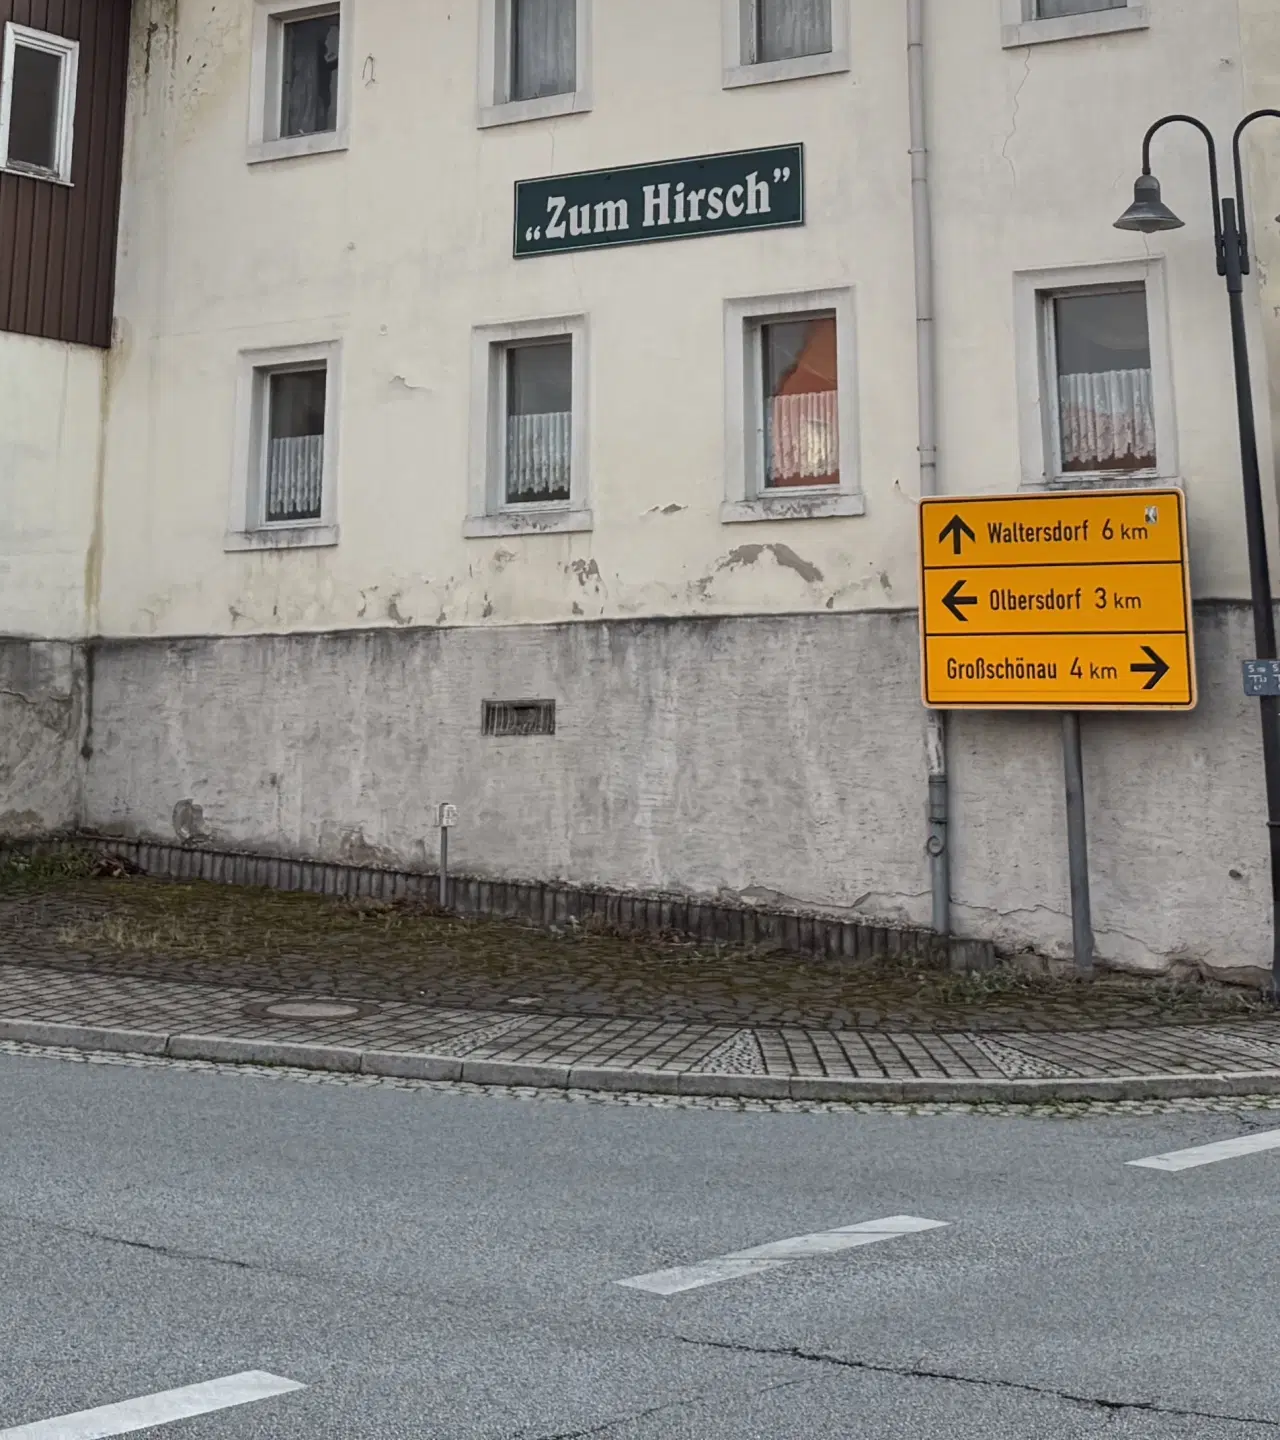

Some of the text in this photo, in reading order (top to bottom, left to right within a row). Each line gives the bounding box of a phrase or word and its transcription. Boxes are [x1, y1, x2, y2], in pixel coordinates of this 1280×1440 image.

[987, 518, 1148, 544] Waltersdorf 6 km
[989, 587, 1142, 610] Olbersdorf 3 km
[947, 657, 1117, 679] Großschönau 4 km
